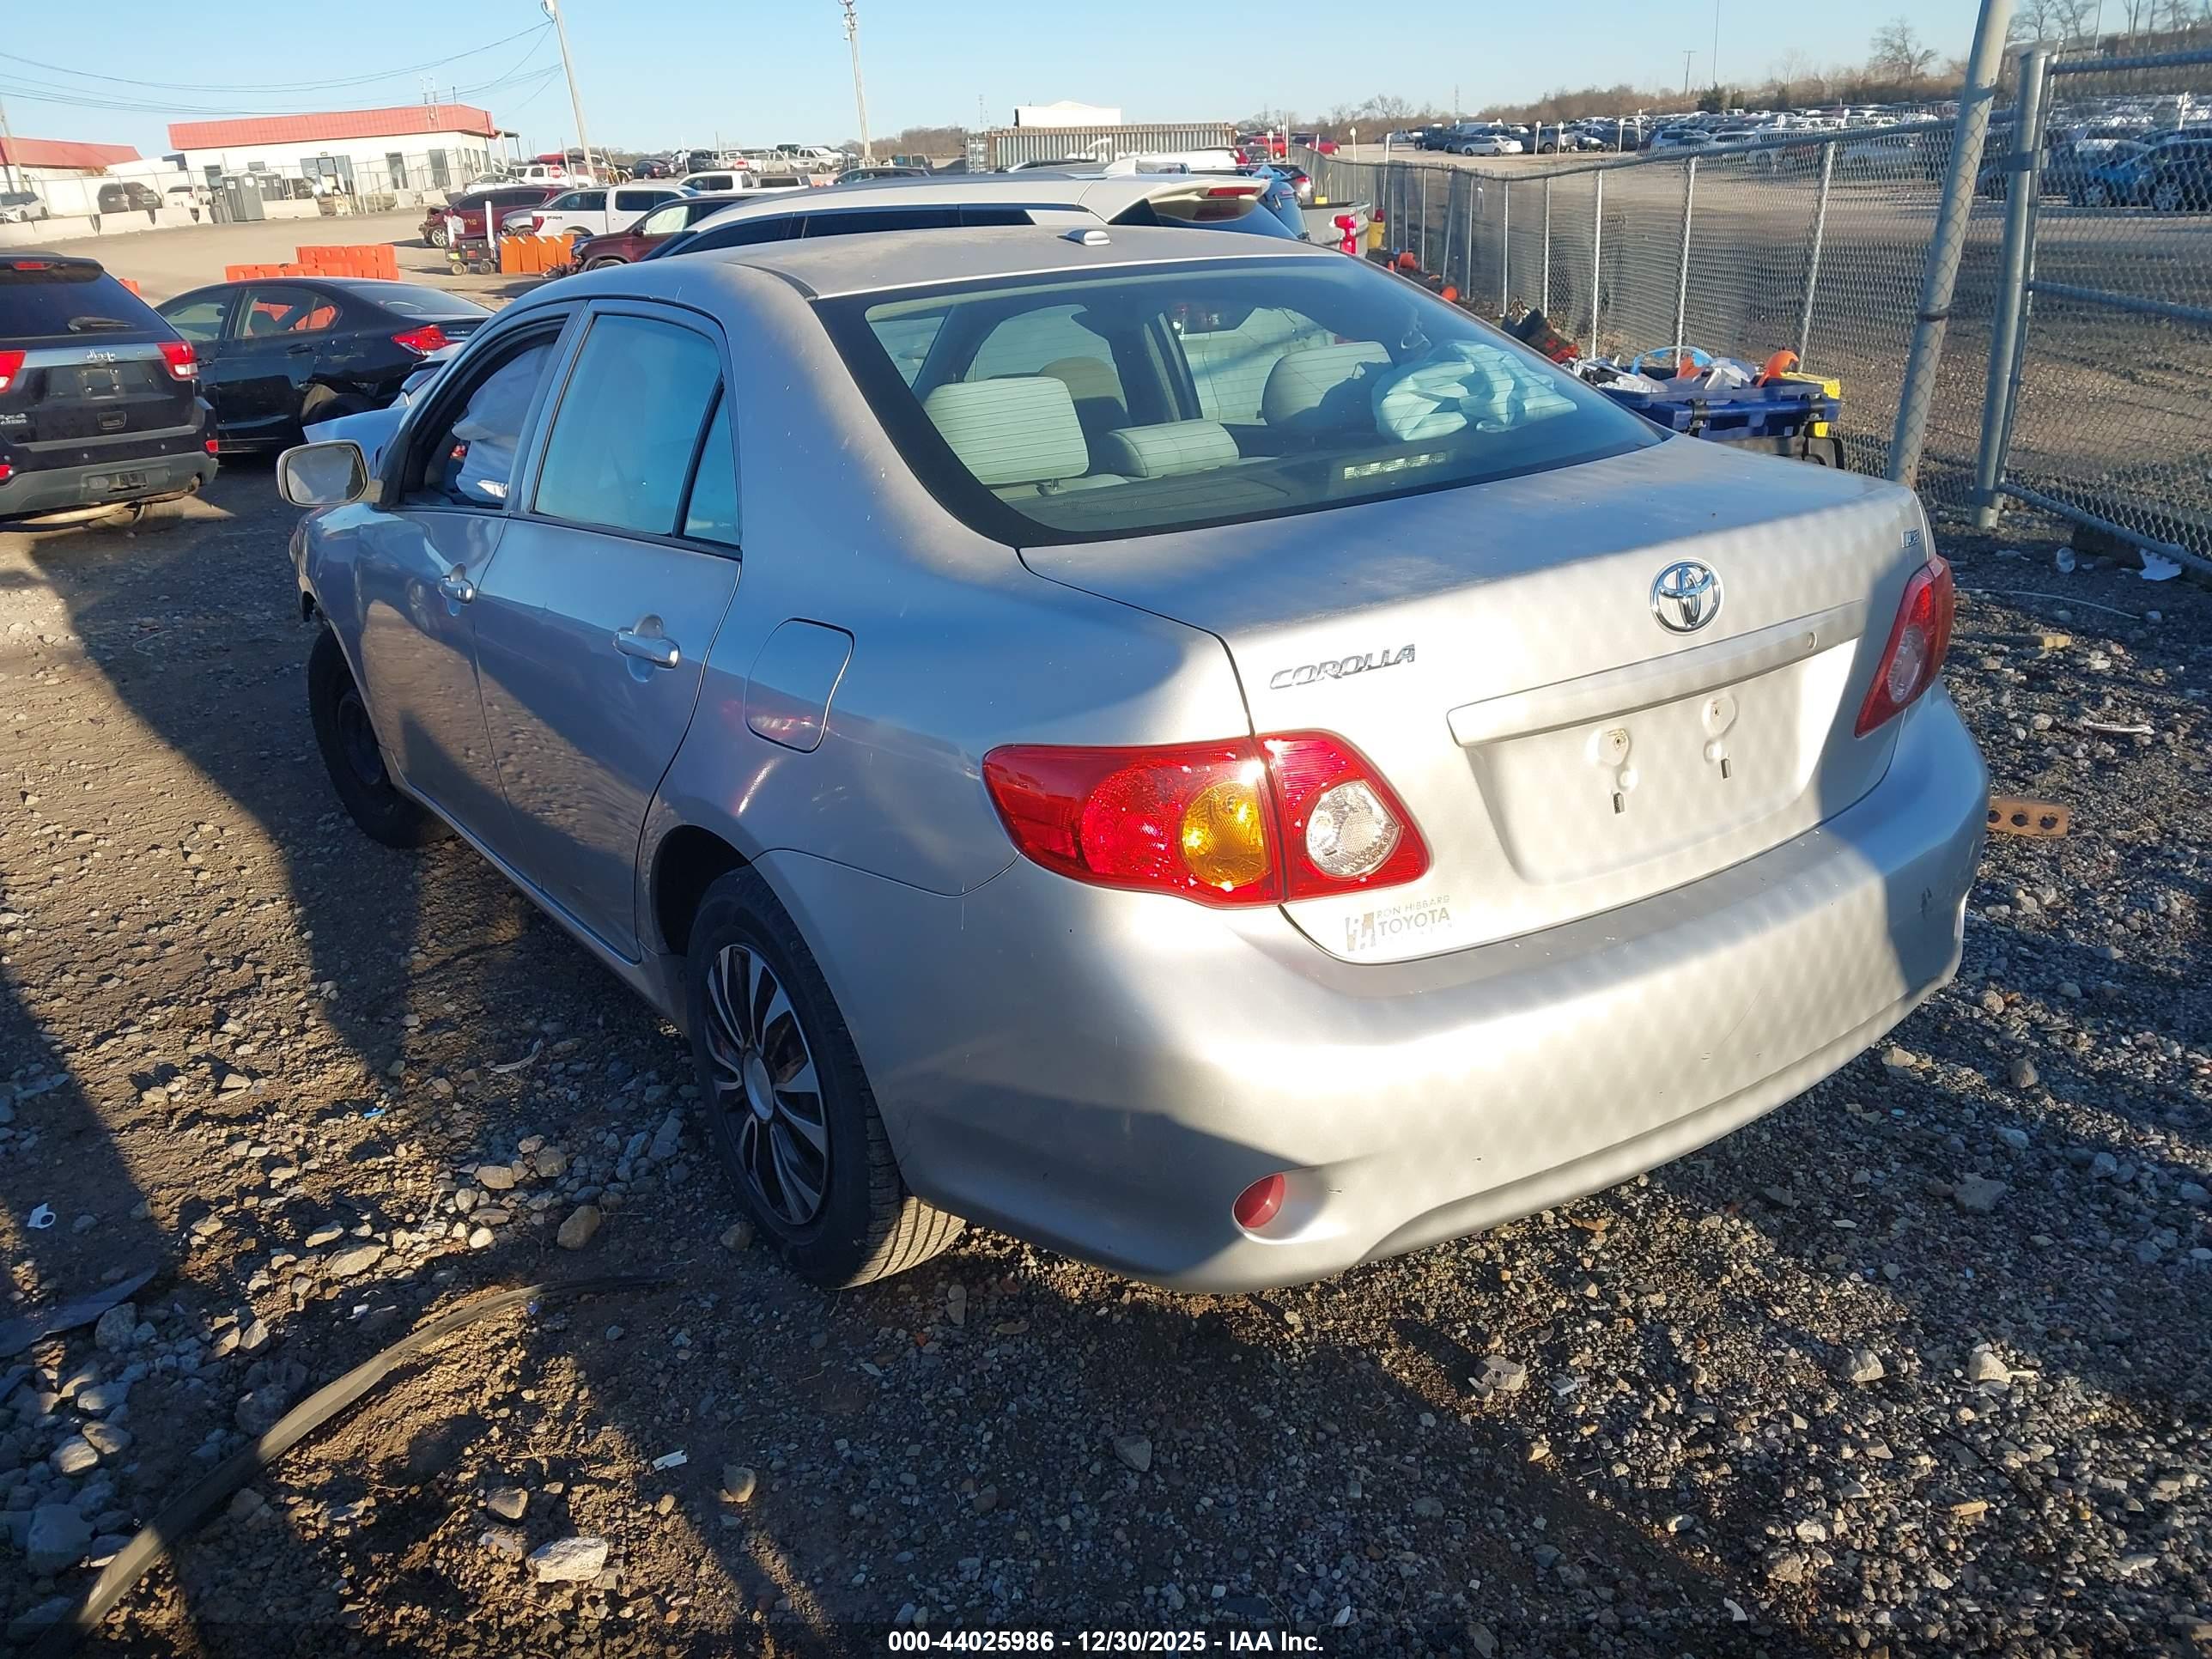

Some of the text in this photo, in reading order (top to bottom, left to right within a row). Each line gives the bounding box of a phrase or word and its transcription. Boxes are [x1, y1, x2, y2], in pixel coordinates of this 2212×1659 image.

[1270, 644, 1416, 690] COROLLA
[1376, 895, 1450, 920] RON HIBBARD
[1378, 907, 1450, 936] TOYOTA
